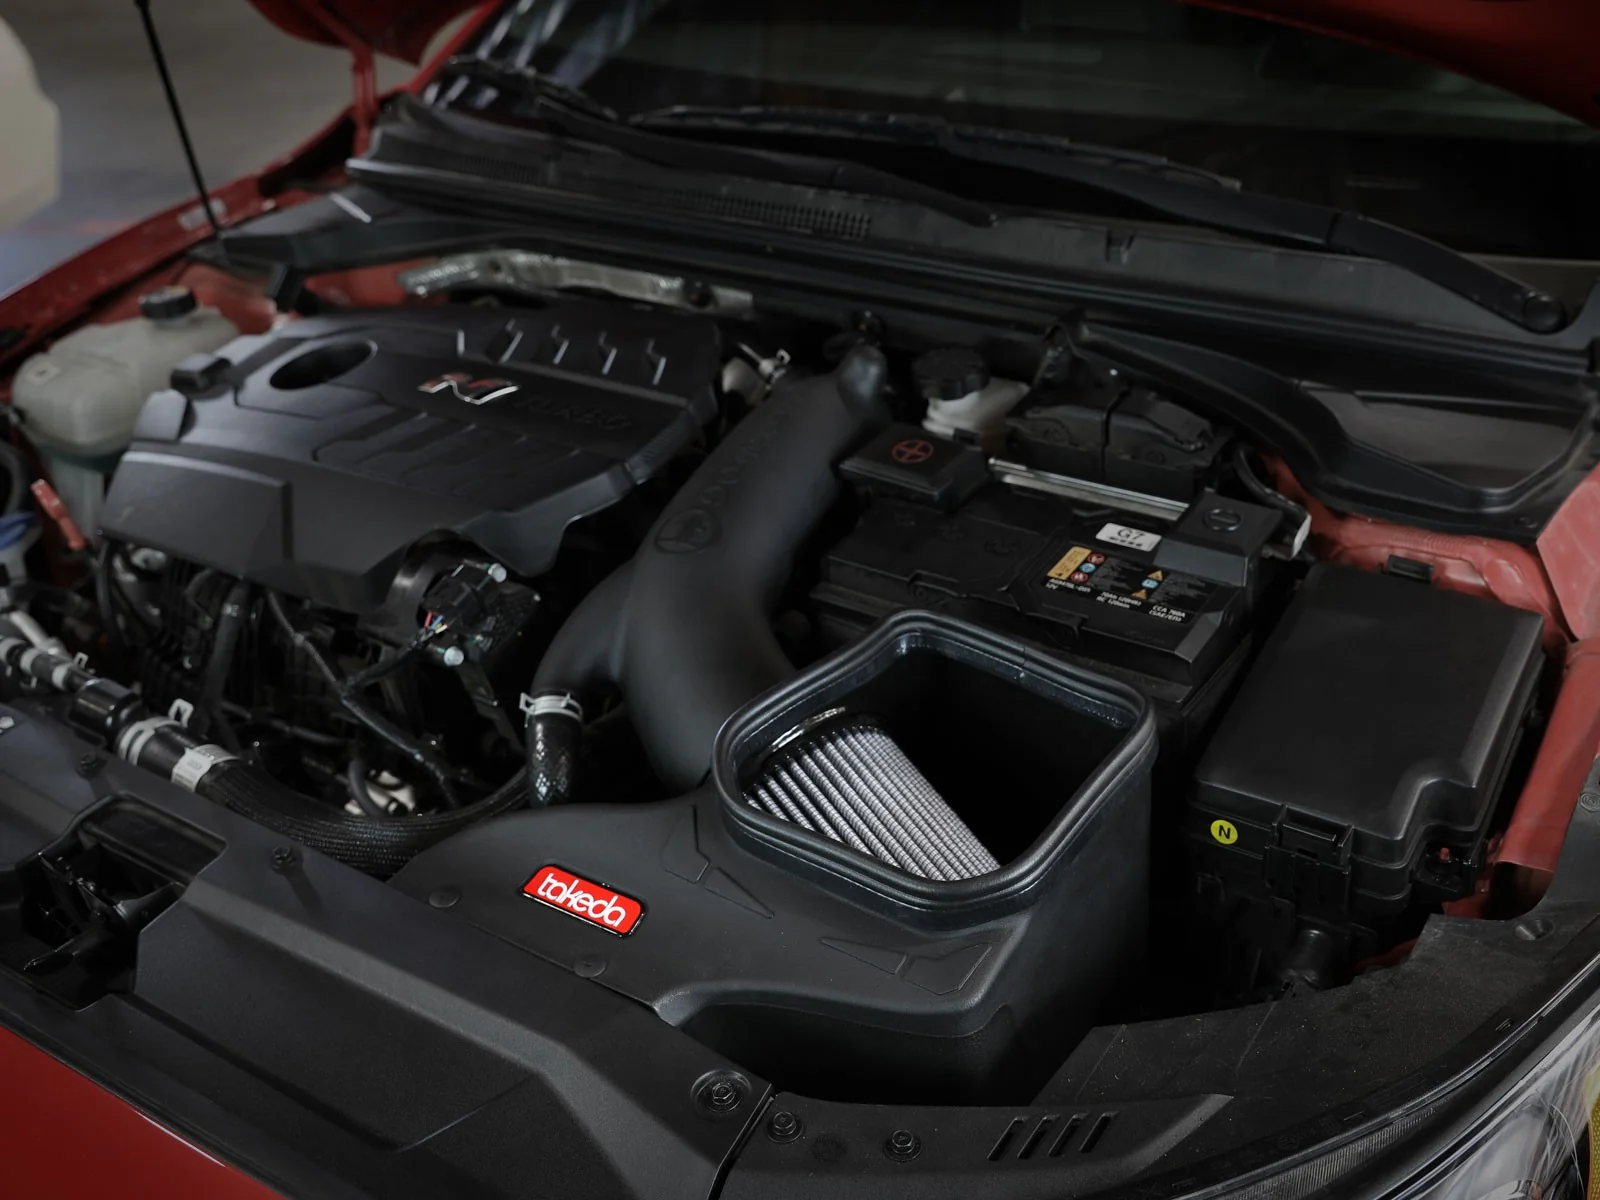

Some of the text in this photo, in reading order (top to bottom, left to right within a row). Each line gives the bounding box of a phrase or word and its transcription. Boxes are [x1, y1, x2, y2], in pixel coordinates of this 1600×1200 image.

[1117, 527, 1146, 540] G7
[1152, 604, 1168, 613] CCA
[1219, 825, 1230, 839] N
[537, 872, 626, 928] takeda
